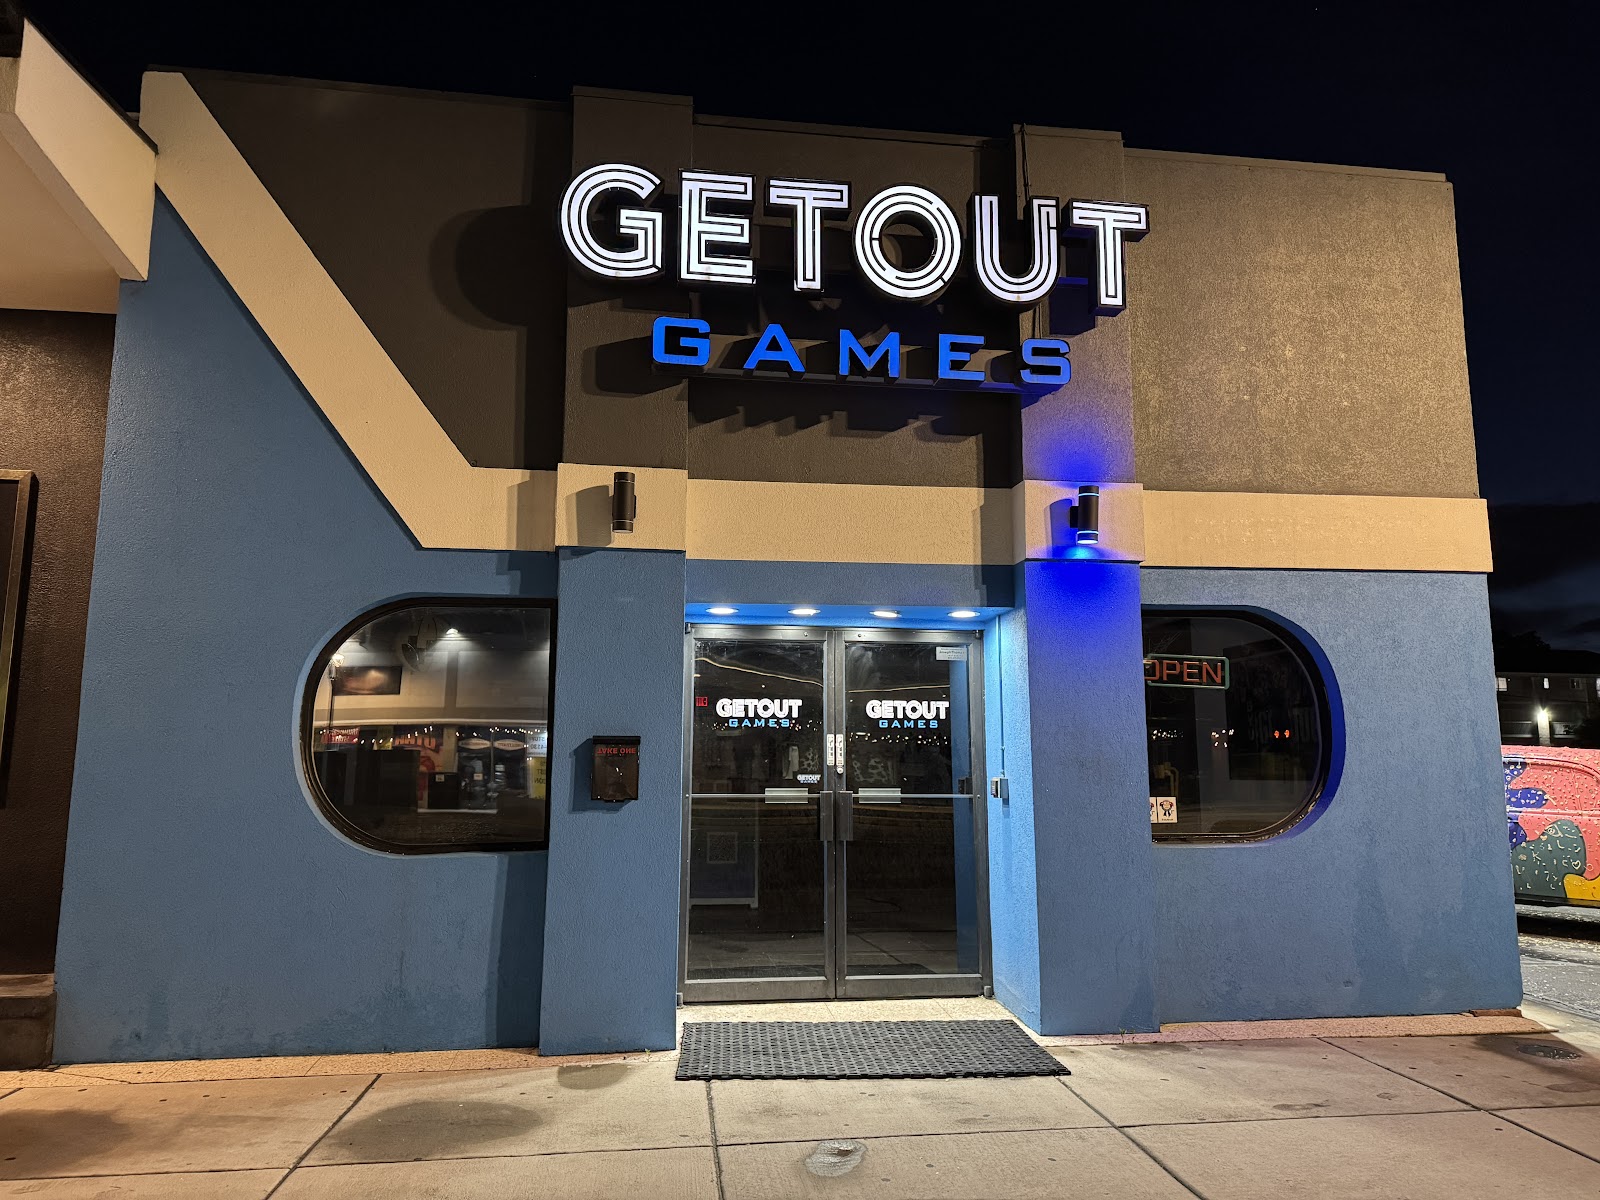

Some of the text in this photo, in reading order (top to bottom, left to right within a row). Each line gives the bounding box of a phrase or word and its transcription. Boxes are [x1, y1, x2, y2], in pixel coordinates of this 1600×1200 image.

[559, 162, 1148, 312] GETOUT
[651, 316, 1072, 386] GAMES
[1143, 659, 1222, 684] OPEN
[715, 698, 803, 719] GETOUT
[865, 699, 950, 720] GETOUT
[728, 718, 790, 728] GAMES
[878, 719, 939, 729] GAMES
